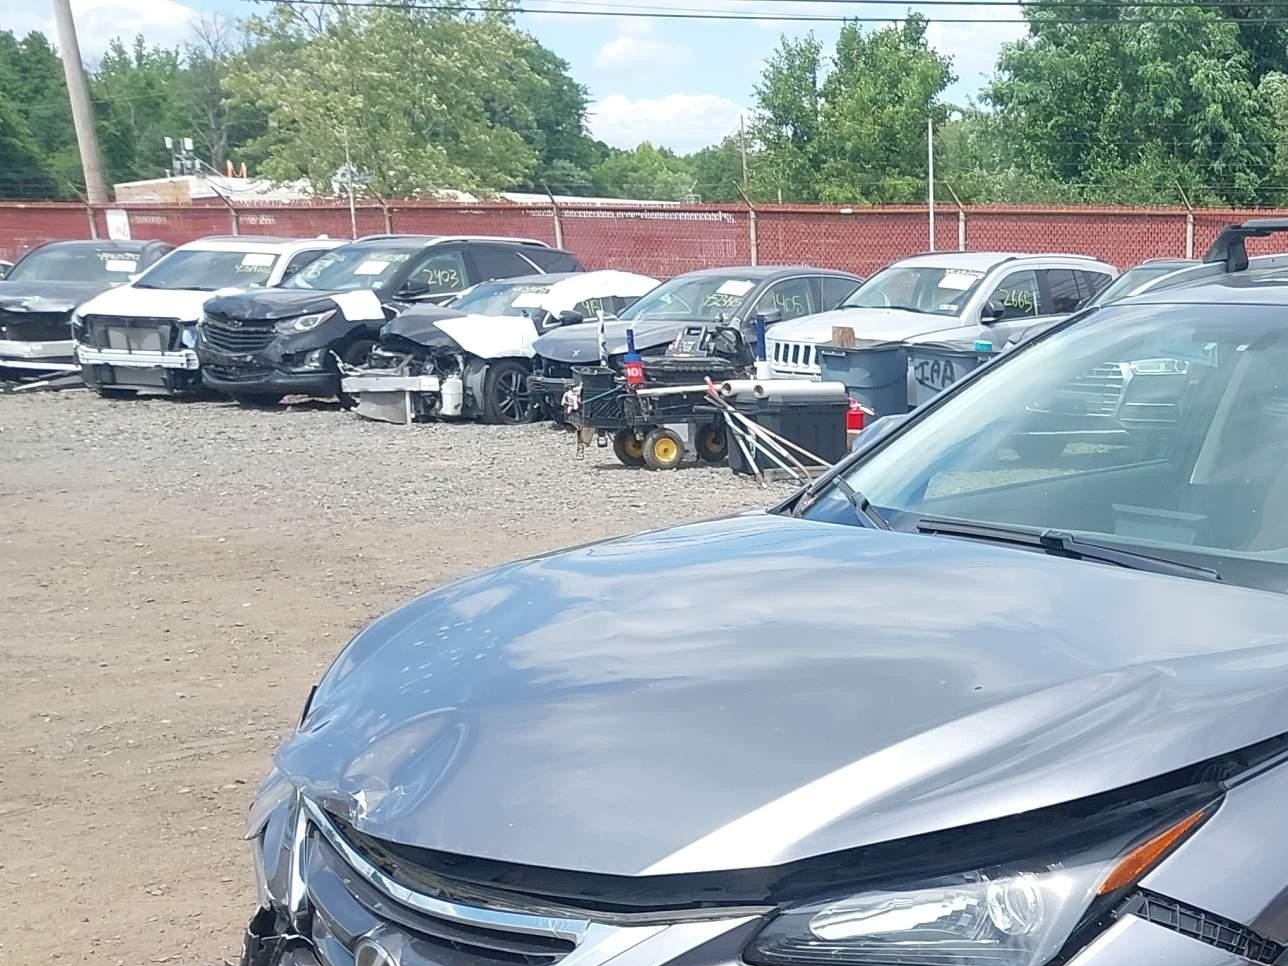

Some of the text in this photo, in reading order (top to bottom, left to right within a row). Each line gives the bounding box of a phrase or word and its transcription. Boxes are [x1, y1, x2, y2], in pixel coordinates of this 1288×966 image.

[423, 269, 459, 288] 2403
[1000, 288, 1033, 312] 2665
[914, 360, 956, 388] IAA
